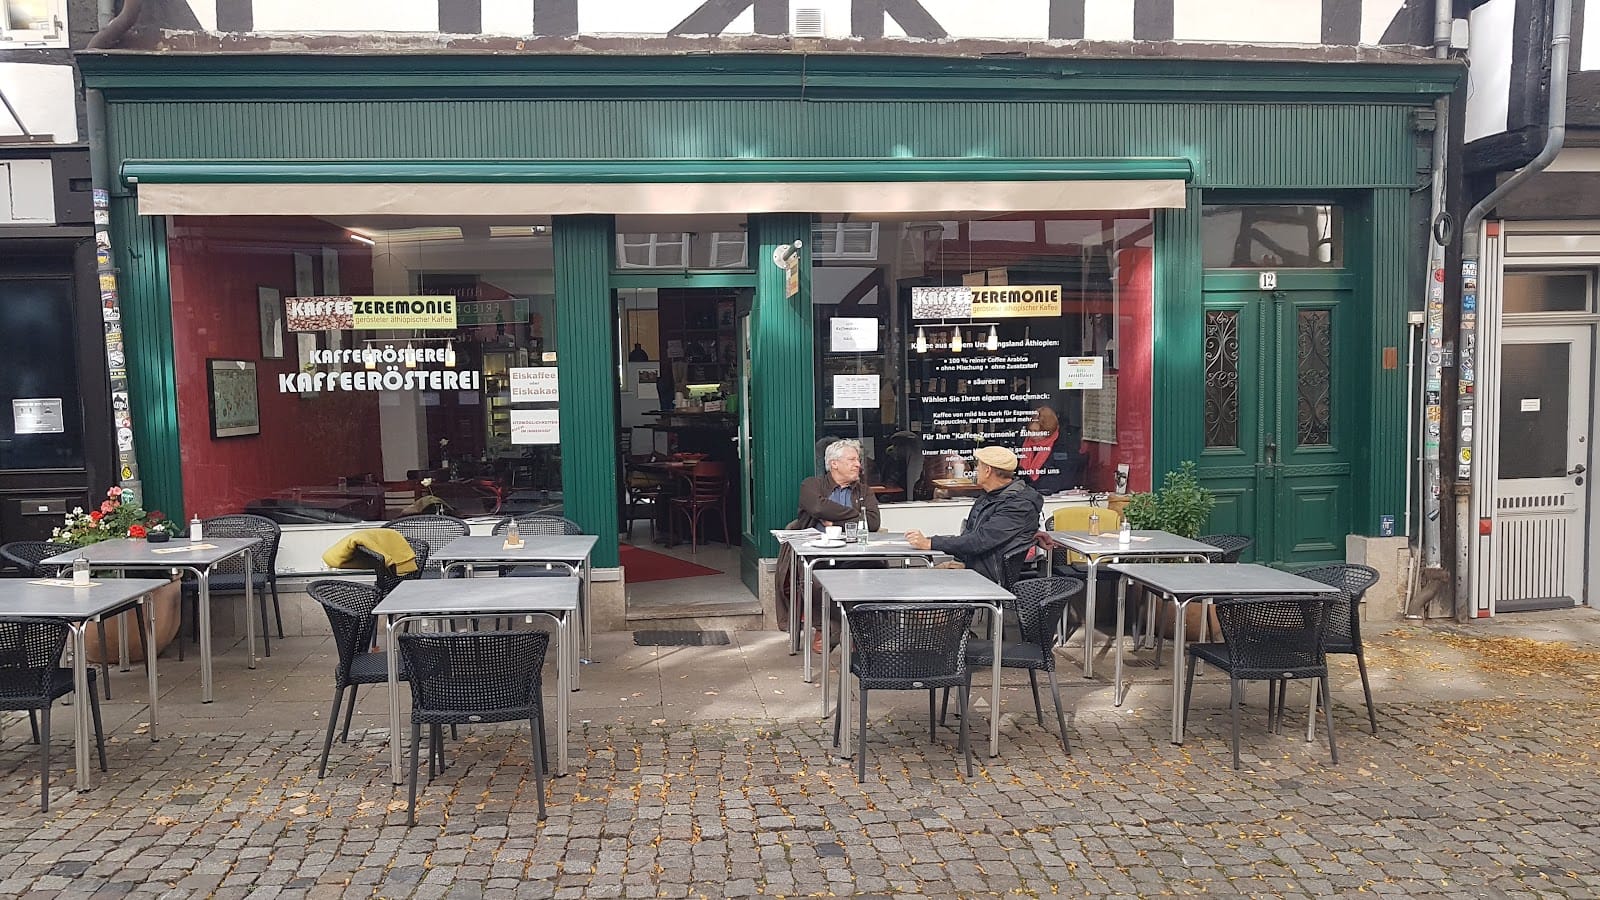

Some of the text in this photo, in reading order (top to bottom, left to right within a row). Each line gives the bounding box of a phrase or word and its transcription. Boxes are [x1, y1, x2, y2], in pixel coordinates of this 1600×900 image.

[1263, 273, 1274, 287] 12
[432, 315, 453, 323] Kaffee
[1025, 337, 1060, 348] Äthiopien:
[956, 363, 984, 372] Mischung
[279, 365, 480, 393] KAFFEERÖSTEREI
[512, 371, 556, 380] Eiskaffee
[973, 378, 1006, 386] säurearm
[512, 387, 557, 396] Eiskakao
[921, 394, 948, 403] Wählen
[961, 394, 981, 402] Ihren
[981, 394, 1009, 403] eigenen
[1010, 393, 1050, 402] Geschmack:
[922, 432, 934, 440] Für
[936, 432, 951, 440] Ihre
[939, 448, 959, 456] Kaffee
[1017, 468, 1034, 476] auch
[1035, 467, 1046, 475] bei
